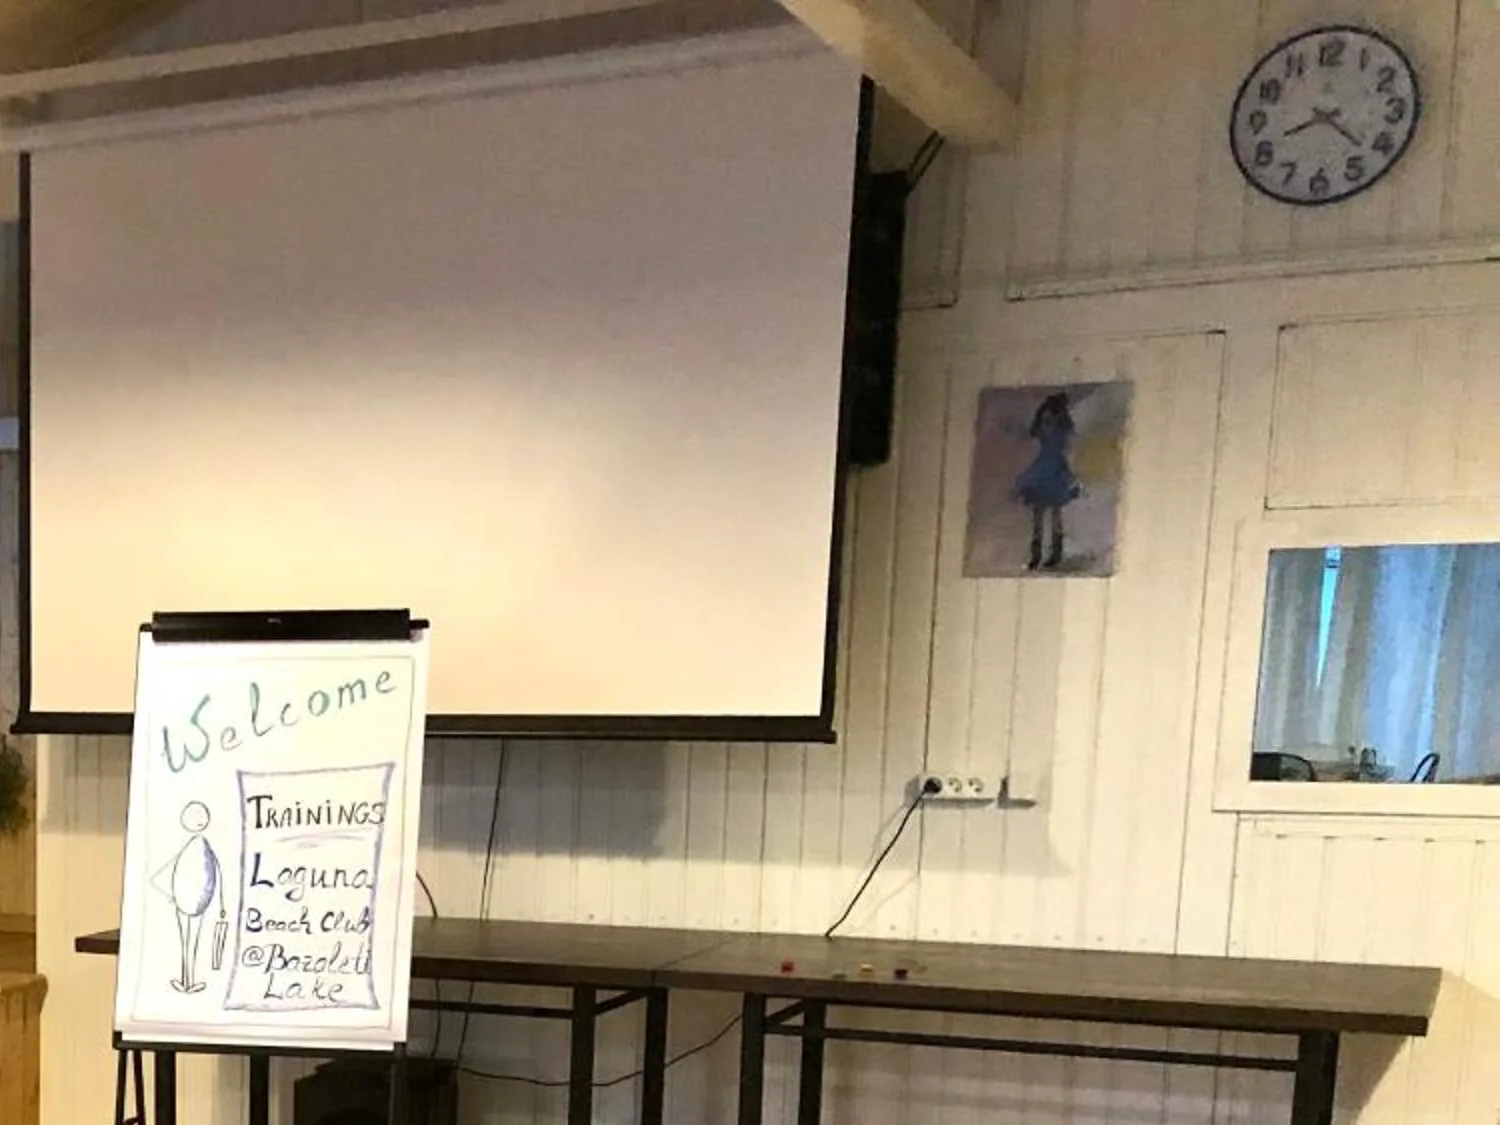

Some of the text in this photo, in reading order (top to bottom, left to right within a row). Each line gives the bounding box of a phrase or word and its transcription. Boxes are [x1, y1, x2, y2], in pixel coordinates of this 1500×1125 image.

[1285, 51, 1305, 79] 11
[1318, 37, 1346, 67] 12
[1359, 47, 1371, 72] 1
[1259, 78, 1281, 105] 10
[1376, 65, 1397, 94] 2
[1249, 109, 1268, 136] 9
[1384, 97, 1405, 125] 3
[1255, 140, 1274, 166] 8
[1371, 131, 1395, 156] 4
[1279, 161, 1298, 186] 7
[1309, 167, 1330, 196] 6
[1343, 156, 1365, 182] 5
[160, 669, 399, 774] Welcome
[250, 852, 374, 902] Laguna
[245, 905, 373, 935] Beach Club
[263, 972, 344, 1003] Lake
